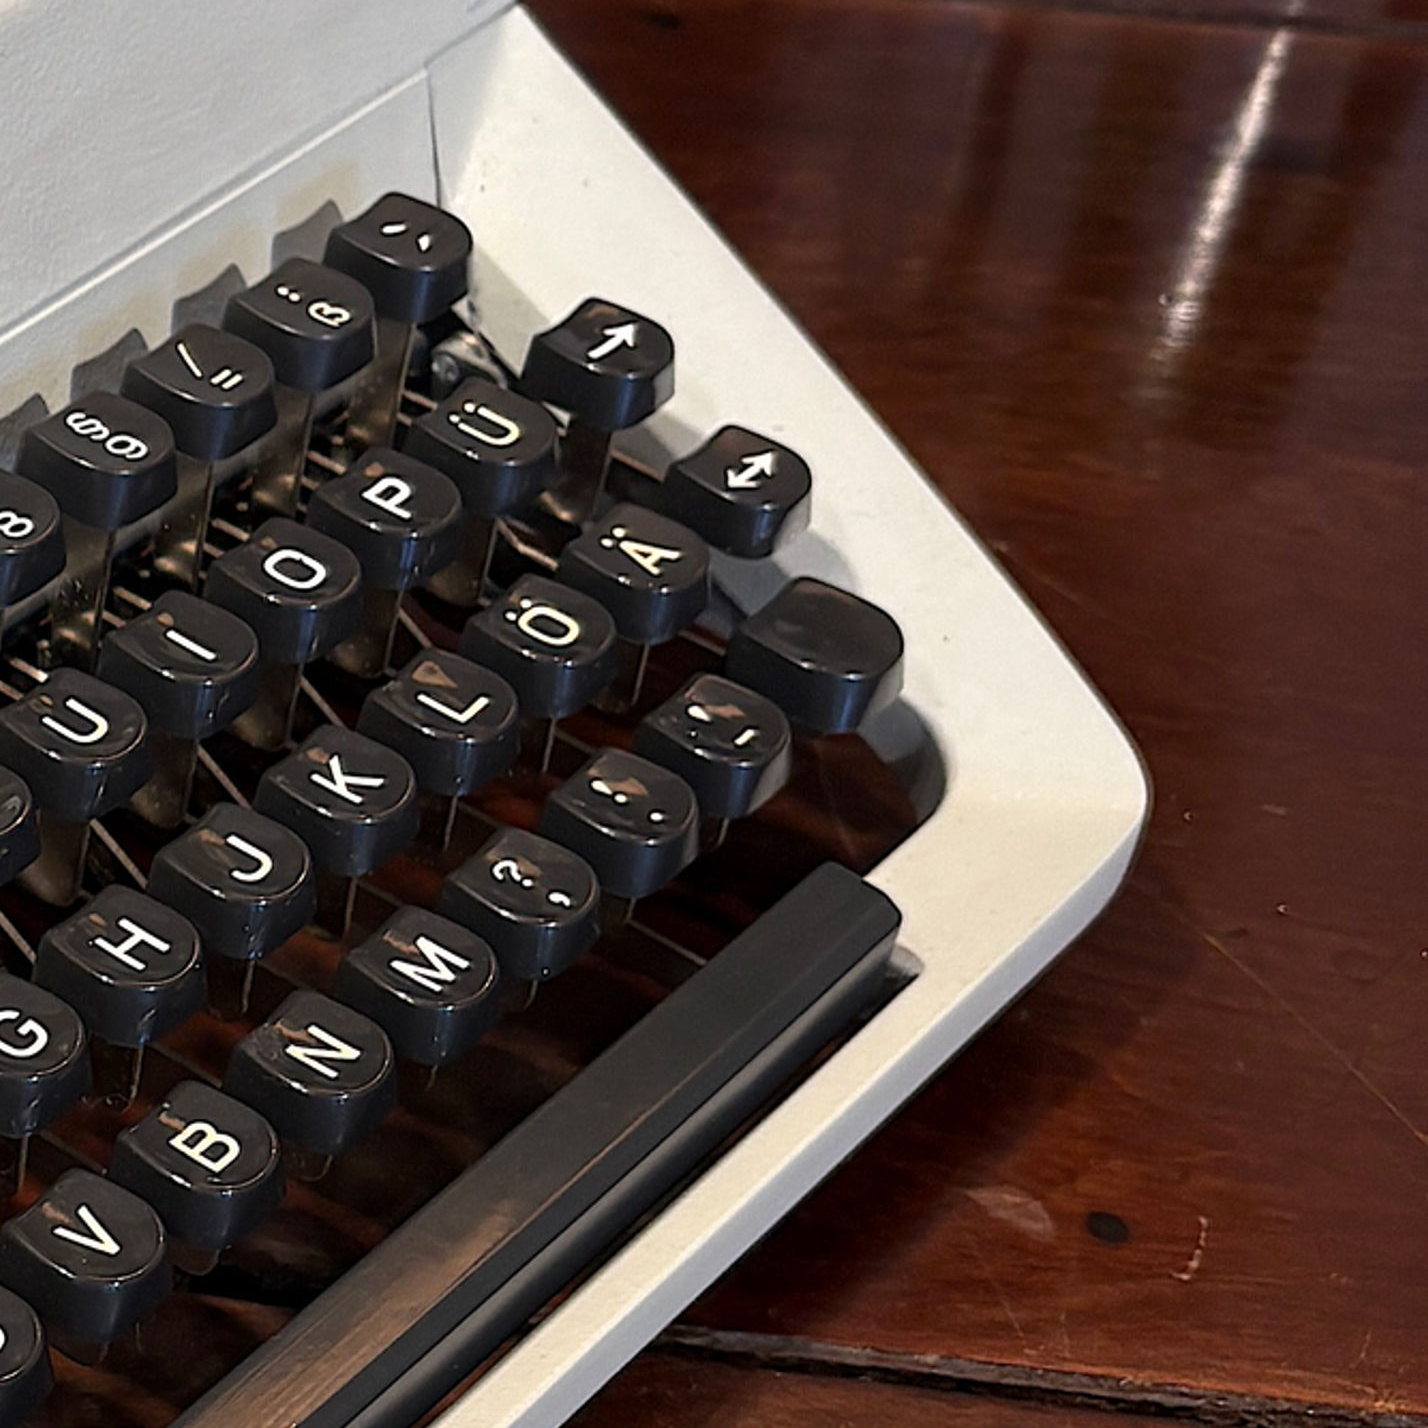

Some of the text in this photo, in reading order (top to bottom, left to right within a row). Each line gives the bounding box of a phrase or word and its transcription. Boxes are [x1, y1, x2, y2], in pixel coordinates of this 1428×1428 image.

[104, 434, 149, 460] 9
[448, 401, 521, 447] Ü
[361, 476, 413, 520] P
[262, 548, 328, 590] O
[600, 526, 682, 576] Ä
[165, 629, 217, 661] I
[504, 597, 581, 646] Ö
[41, 697, 110, 744] U
[416, 693, 491, 724] L
[309, 754, 386, 805] K
[225, 834, 274, 883] J
[491, 859, 534, 888] ?
[93, 917, 171, 971] H
[389, 935, 471, 993] M
[284, 1024, 362, 1079] N
[168, 1121, 241, 1174] B
[52, 1204, 122, 1256] V
